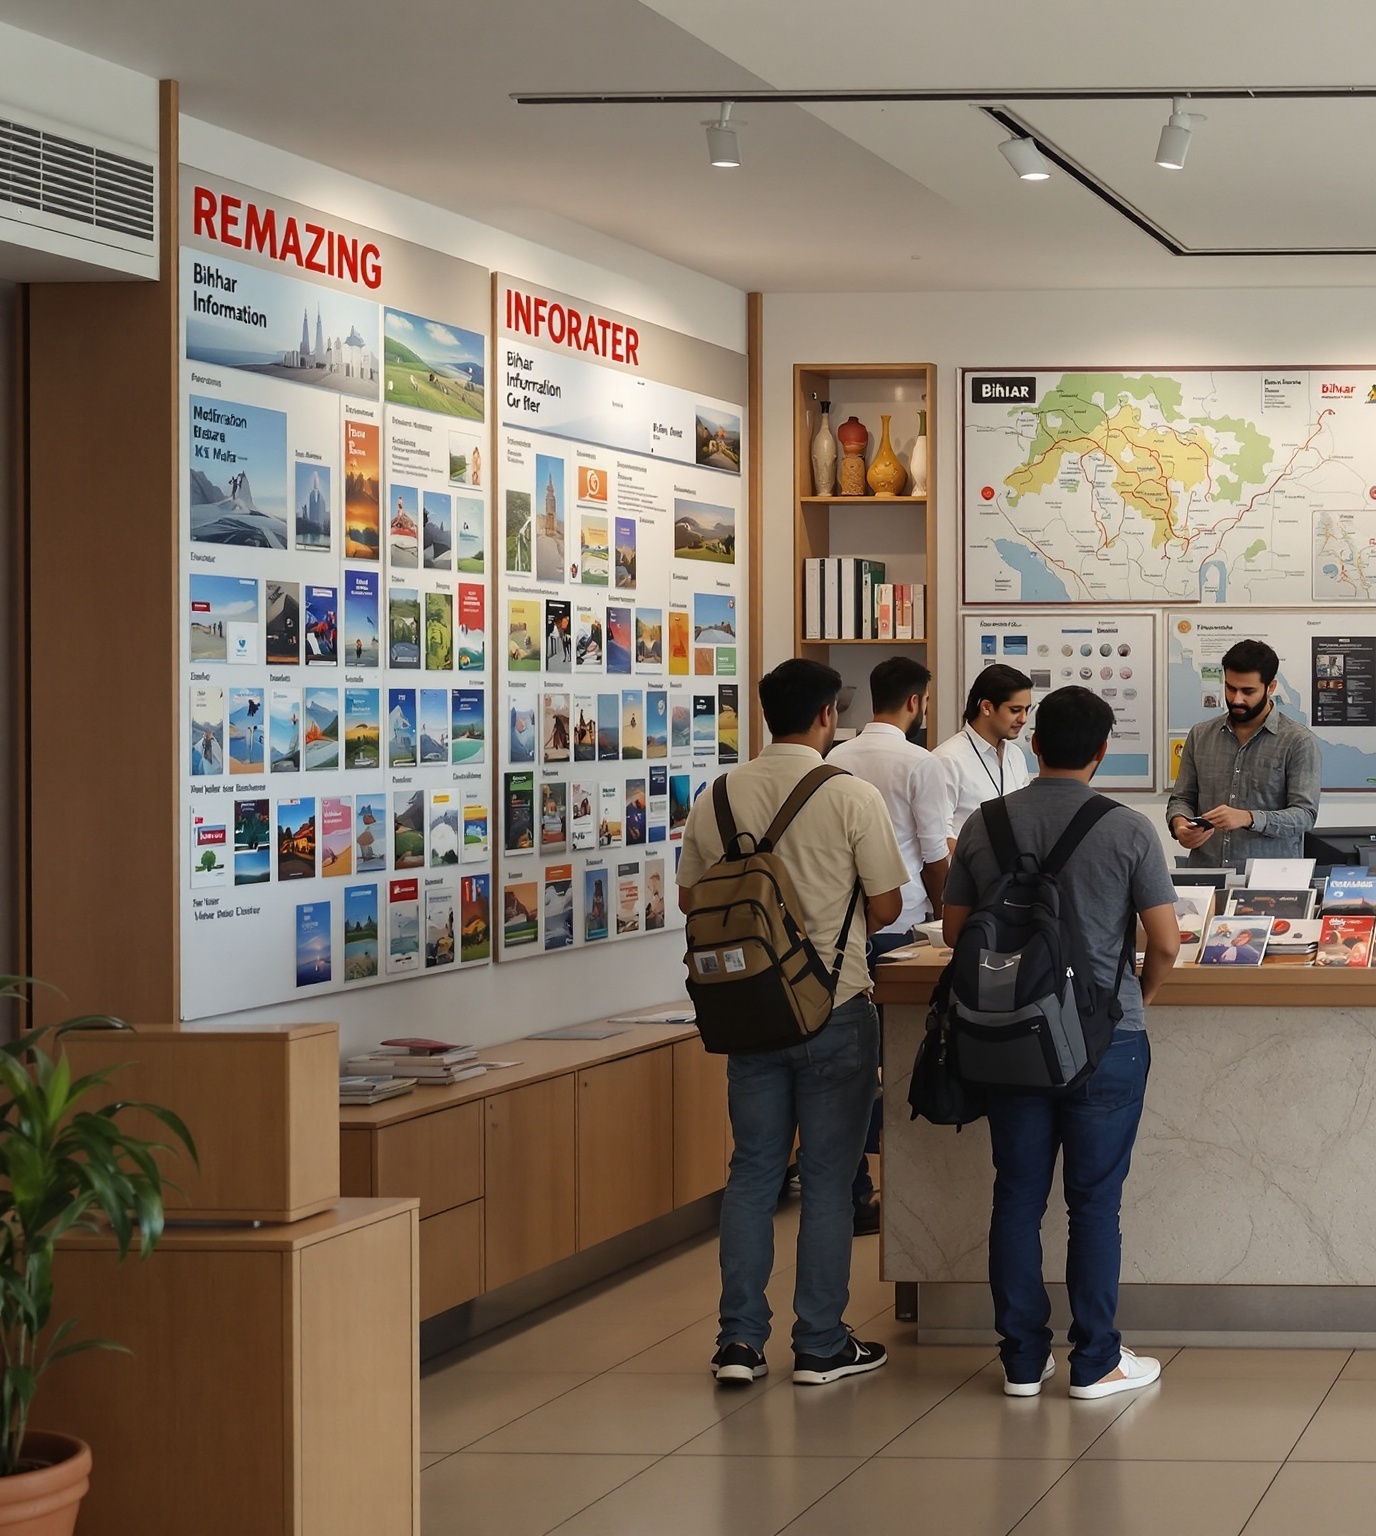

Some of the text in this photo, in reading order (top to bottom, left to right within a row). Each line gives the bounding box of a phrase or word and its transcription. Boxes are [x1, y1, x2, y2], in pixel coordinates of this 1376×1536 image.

[193, 185, 382, 289] REMAZING
[193, 290, 267, 328] Information
[506, 288, 639, 366] INFORATER
